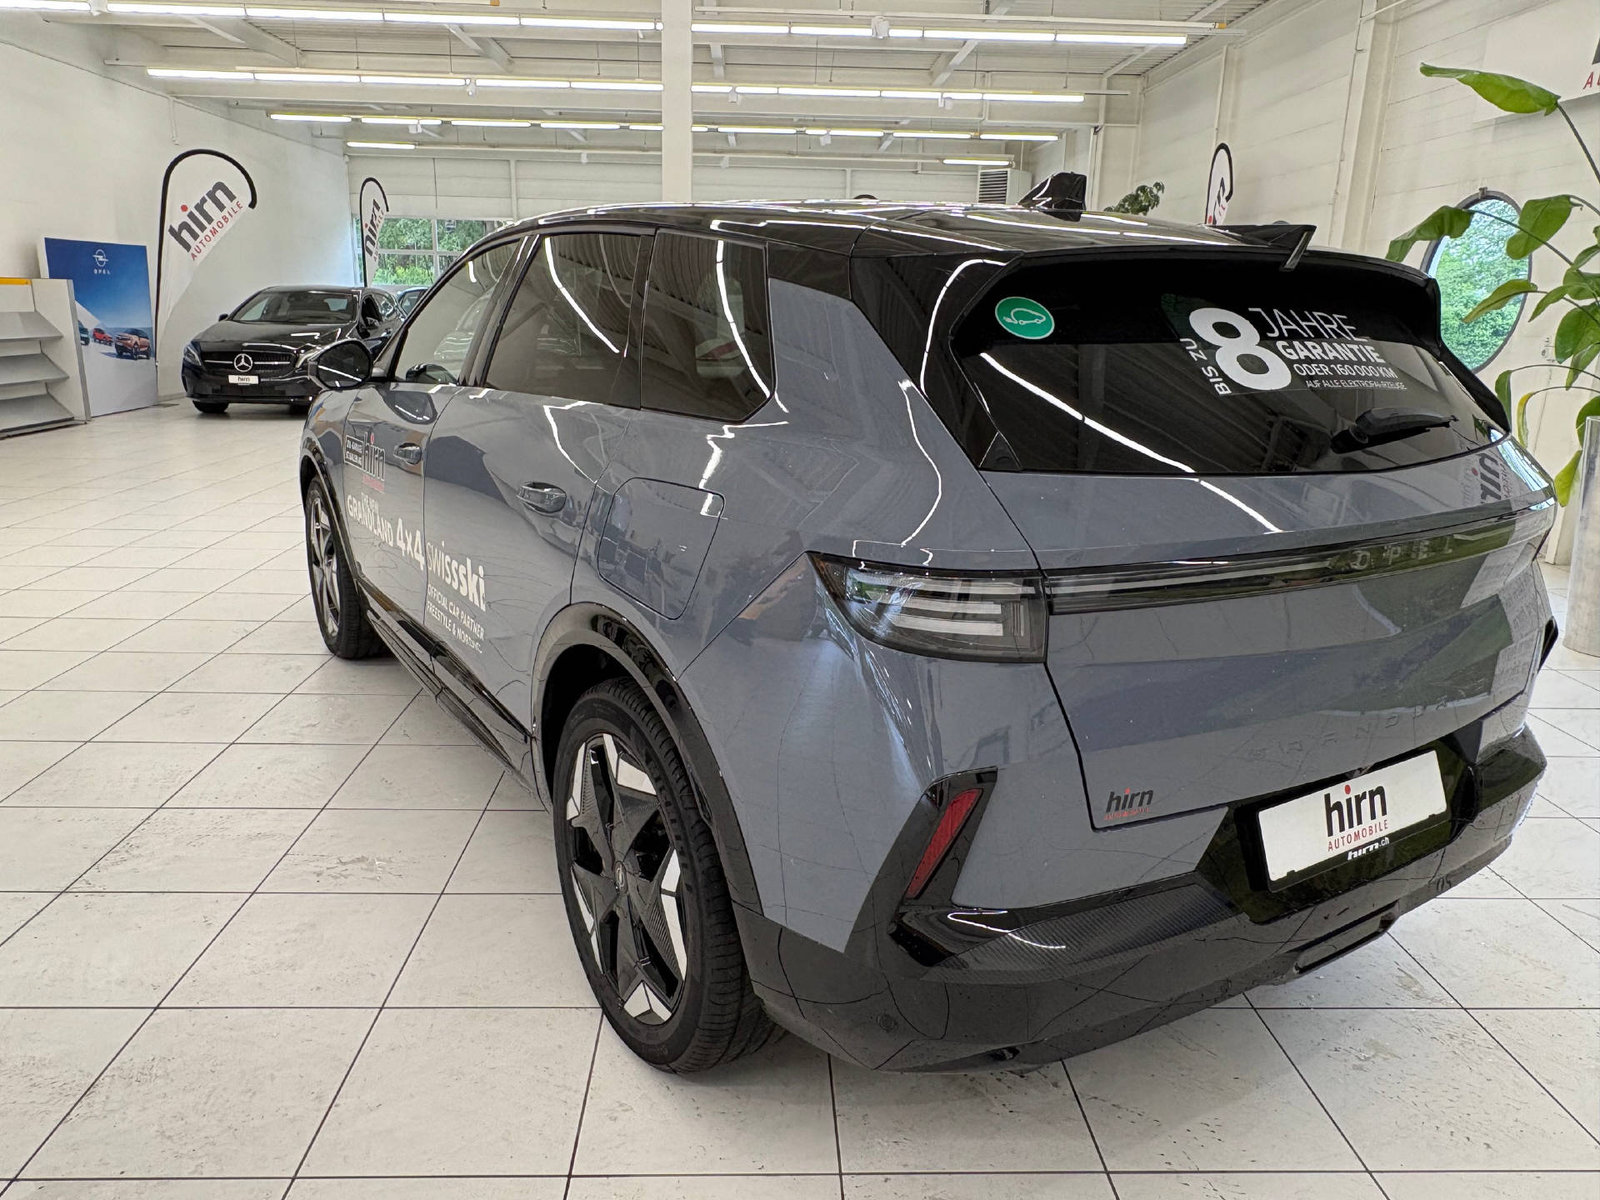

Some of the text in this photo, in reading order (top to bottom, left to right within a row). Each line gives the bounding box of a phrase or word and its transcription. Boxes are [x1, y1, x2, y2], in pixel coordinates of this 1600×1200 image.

[168, 181, 237, 253] hirn
[190, 200, 243, 261] AUTOMOBILE
[1248, 308, 1370, 343] JAHRE
[1180, 338, 1232, 395] BIS ZU
[1189, 307, 1292, 391] 8
[1275, 340, 1387, 364] GARANTIE
[1293, 363, 1334, 376] ODER
[1376, 366, 1399, 379] KM
[1305, 380, 1321, 389] AUF
[1322, 380, 1342, 389] ALLE
[1349, 537, 1453, 570] OPEL
[448, 601, 460, 619] CAR
[460, 611, 485, 641] PARTNER
[1106, 787, 1154, 813] hirn
[1324, 784, 1387, 837] hirn
[1328, 819, 1389, 852] AUTOMOBILE
